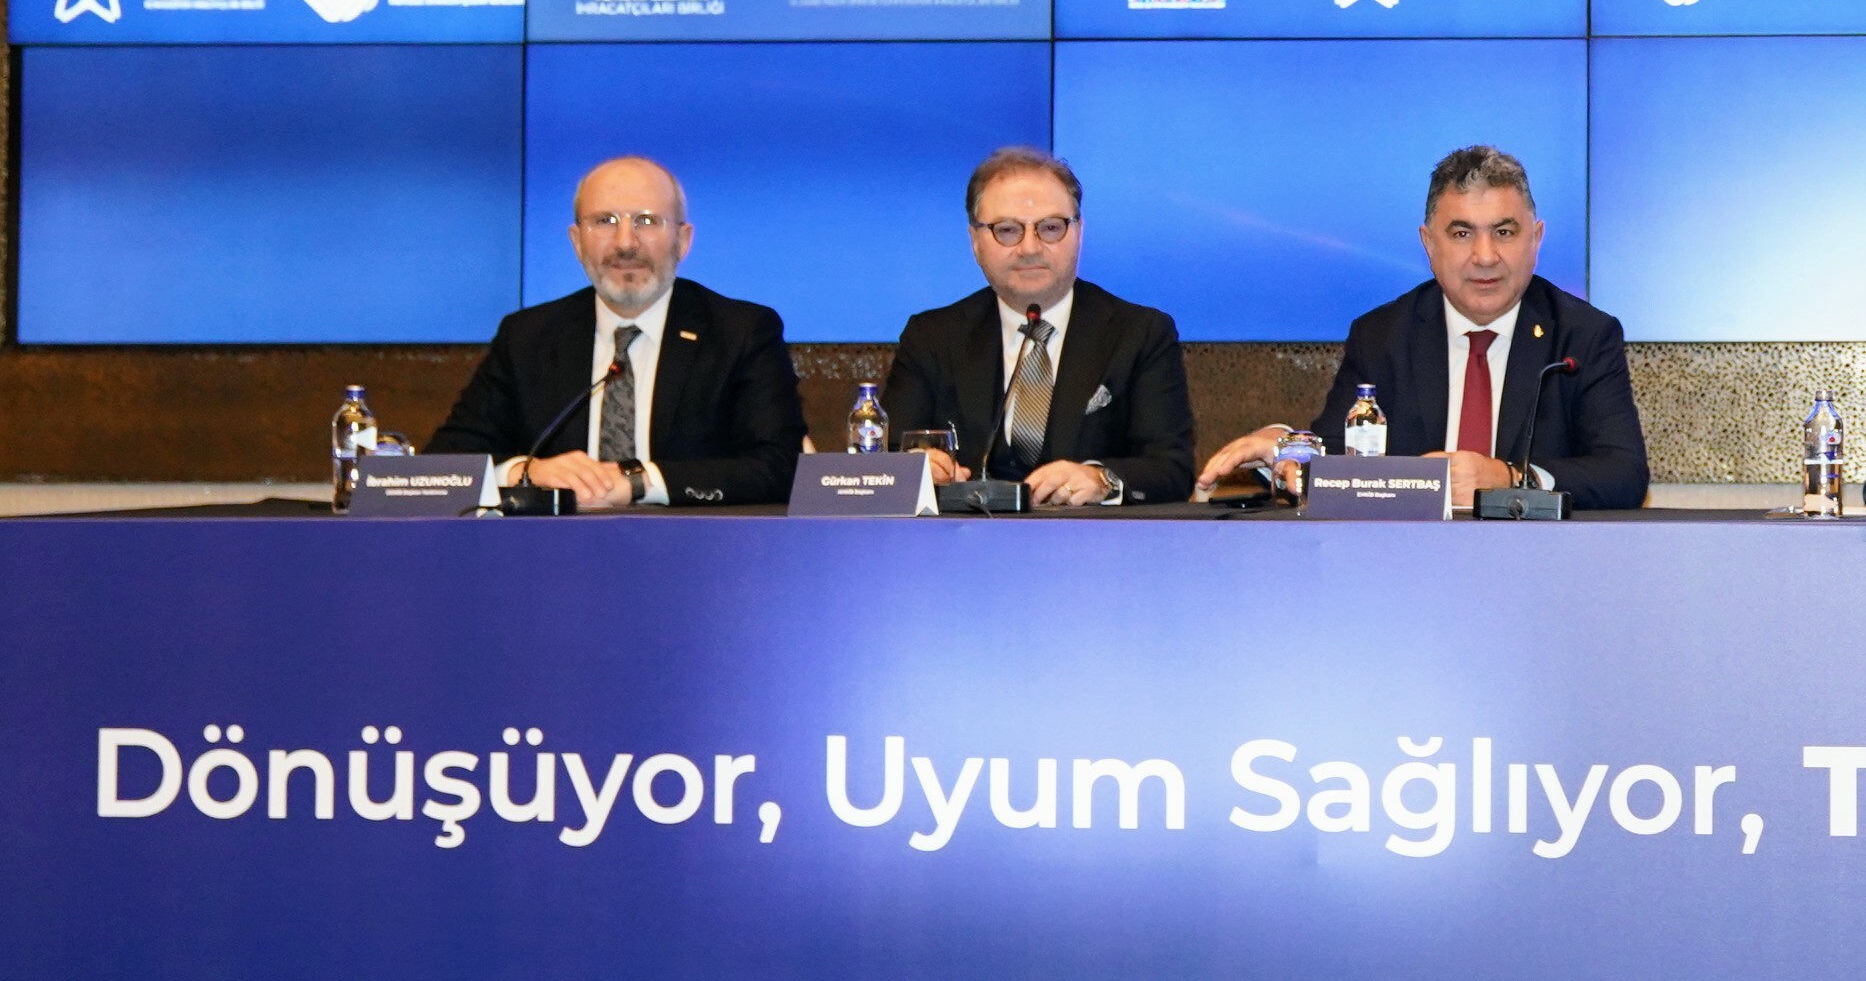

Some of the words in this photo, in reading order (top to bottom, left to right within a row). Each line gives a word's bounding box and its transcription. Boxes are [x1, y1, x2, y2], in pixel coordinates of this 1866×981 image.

[410, 474, 473, 487] UZUNOĞLU
[821, 475, 860, 486] Gürkan
[862, 473, 895, 486] TEKİN
[1314, 478, 1350, 490] Recep
[1352, 478, 1386, 488] Burak
[1388, 479, 1441, 492] SERTBAŞ
[96, 723, 781, 849] Dönüşüyor,
[826, 734, 1186, 852] Uyum
[1229, 736, 1761, 859] Sağlıyor,
